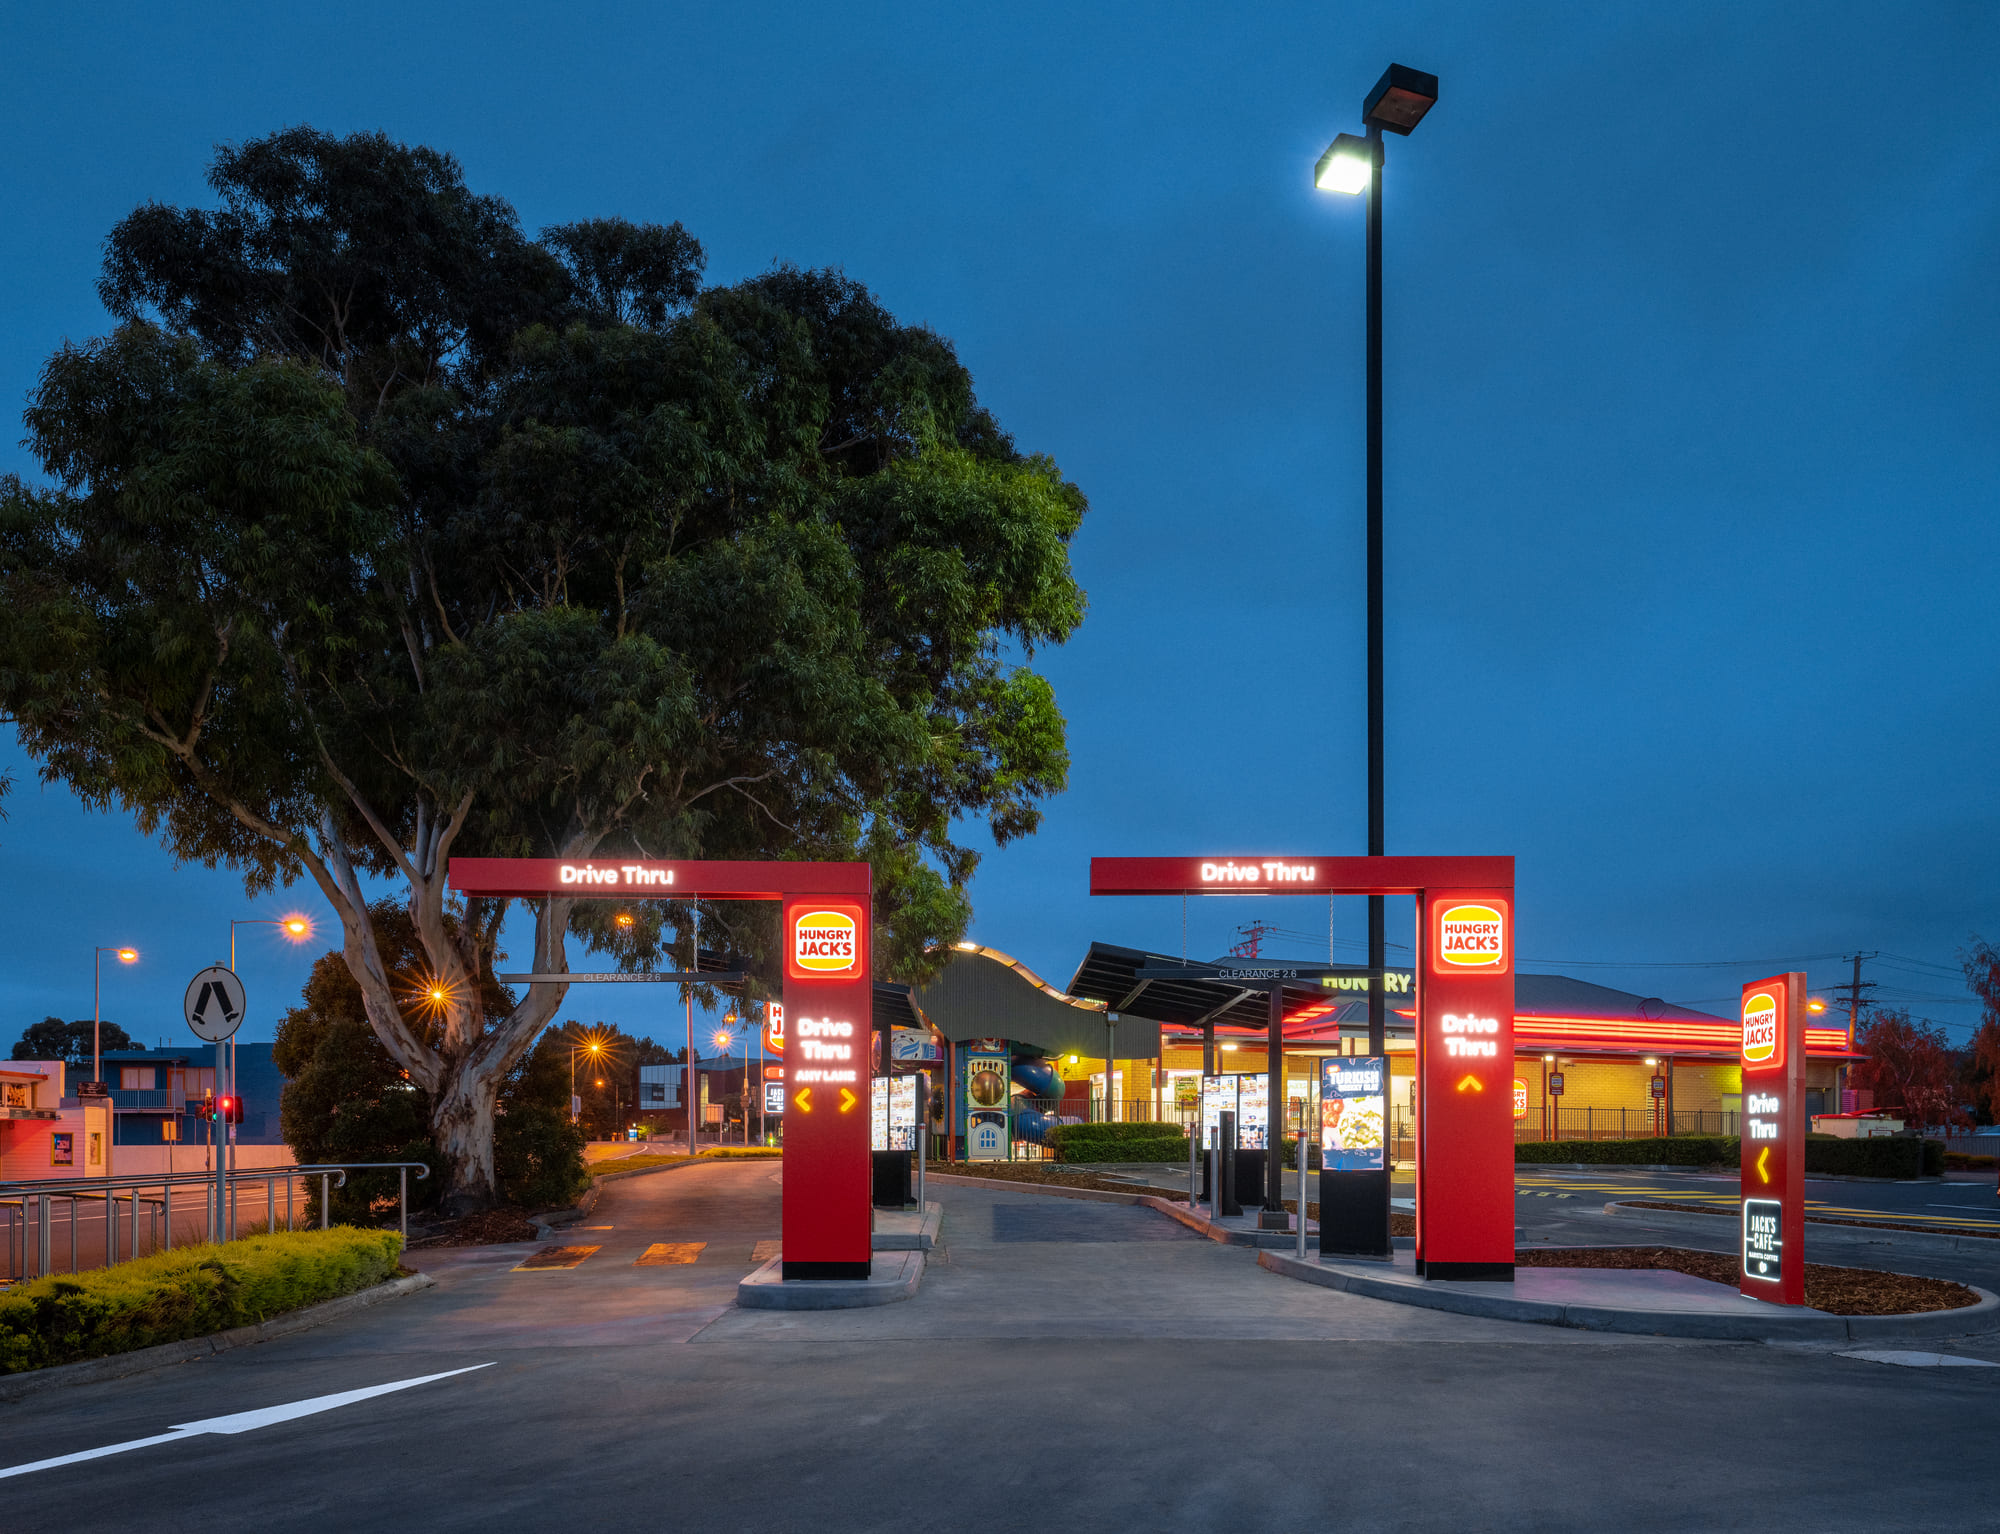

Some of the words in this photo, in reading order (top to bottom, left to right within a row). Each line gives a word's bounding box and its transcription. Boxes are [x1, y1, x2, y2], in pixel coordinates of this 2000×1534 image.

[560, 865, 618, 884] Drive
[621, 865, 674, 884] Thru
[1201, 862, 1259, 881] Drive
[1262, 862, 1316, 881] Thru
[799, 930, 852, 940] HUNGRY
[1445, 924, 1499, 934] HUNGRY
[799, 942, 852, 956] JACK'S
[1445, 936, 1499, 950] JACK'S
[583, 973, 644, 982] CLEARANCE
[647, 973, 661, 982] 2.6
[1219, 970, 1279, 978] CLEARANCE
[1282, 970, 1297, 978] 2.6
[1322, 972, 1411, 993] HUNRY
[798, 1017, 853, 1036] Drive
[1441, 1013, 1498, 1033] Drive
[1745, 1012, 1774, 1028] HUNGRY
[801, 1041, 851, 1059] Thru
[1444, 1037, 1497, 1056] Thru
[1330, 1071, 1379, 1084] TURKISH
[1748, 1093, 1779, 1114] Drive
[1749, 1118, 1777, 1138] Thru
[1751, 1215, 1776, 1234] JACK'S
[1753, 1232, 1773, 1251] CAFE
